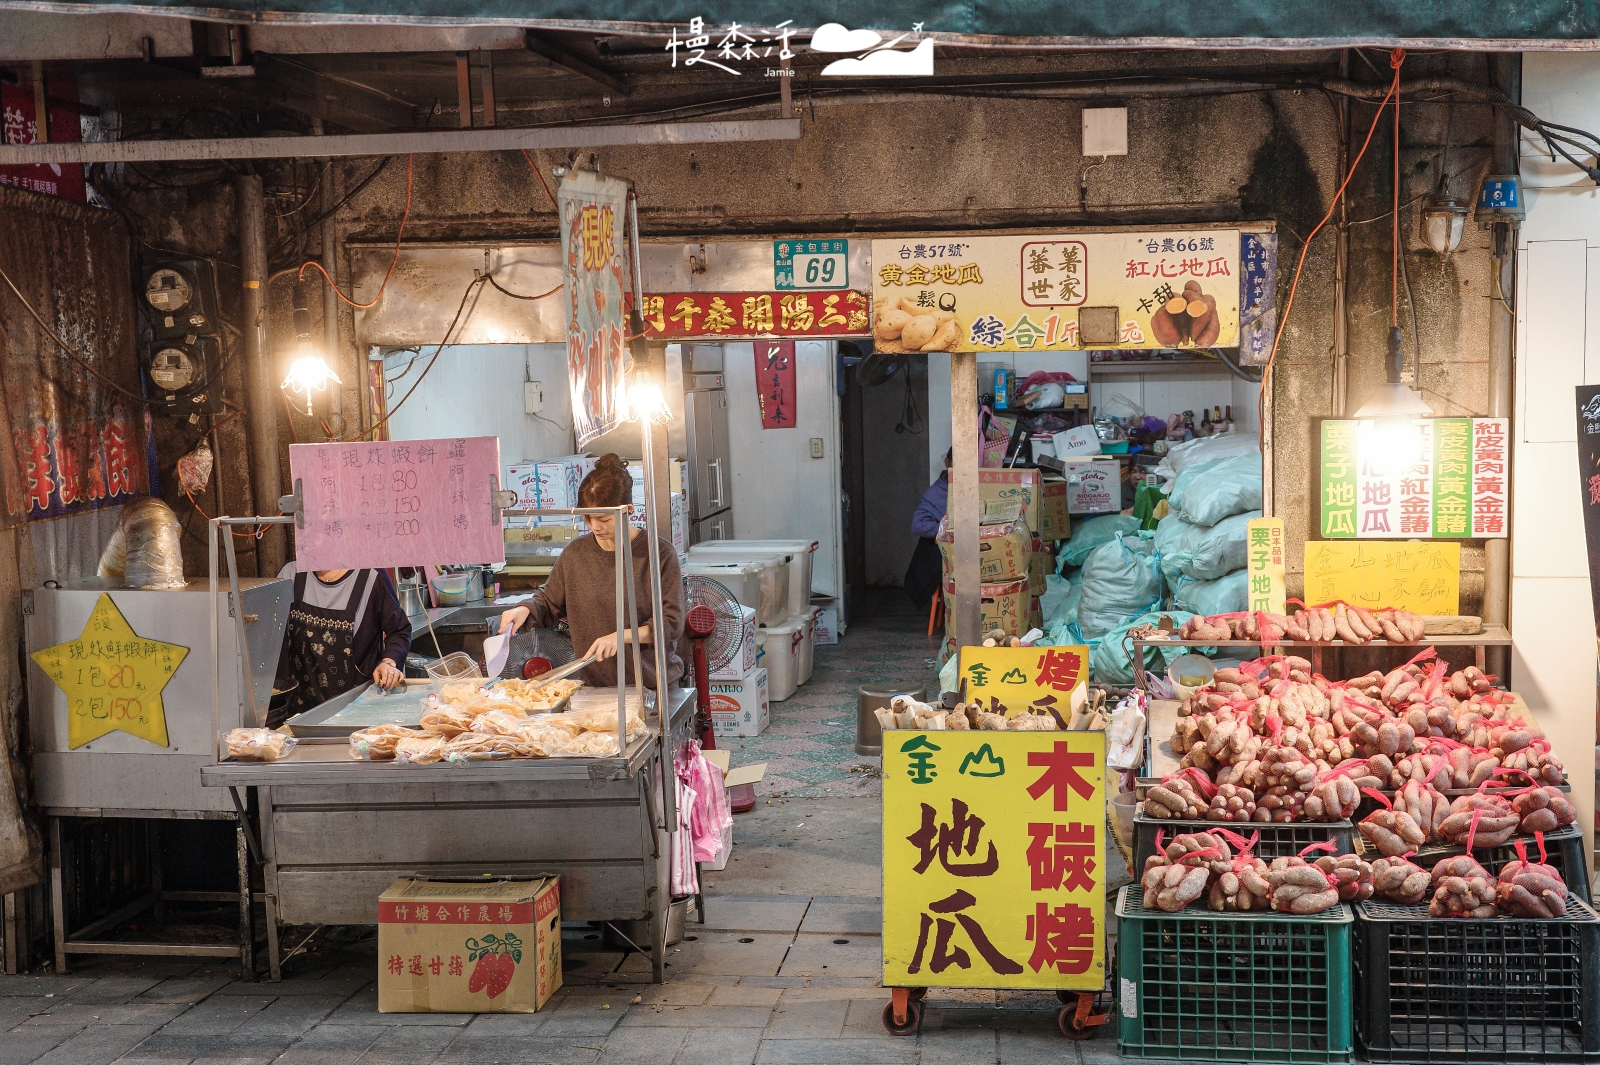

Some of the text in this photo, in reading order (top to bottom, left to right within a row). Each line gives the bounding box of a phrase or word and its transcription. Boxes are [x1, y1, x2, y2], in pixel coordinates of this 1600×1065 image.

[795, 242, 842, 253] 金包里街
[898, 244, 962, 259] 台農57號
[1146, 237, 1215, 253] 台農66號
[1247, 238, 1257, 271] 金山區
[806, 258, 835, 283] 69
[879, 263, 983, 286] 黃金地瓜
[1125, 257, 1231, 278] 紅心地瓜
[1136, 282, 1175, 314] 卡甜
[621, 291, 848, 334] 三陽開泰千門
[1068, 440, 1087, 449] Amo
[1325, 425, 1355, 534] 栗子地瓜
[1271, 528, 1281, 565] 日本品種
[967, 663, 1027, 687] 金山
[1035, 650, 1081, 691] 烤
[710, 685, 743, 693] OARJO
[900, 735, 1005, 784] 金山
[1026, 741, 1096, 975] 木碳烤
[906, 798, 1024, 975] 地瓜
[394, 905, 513, 922] 竹塘合作農場
